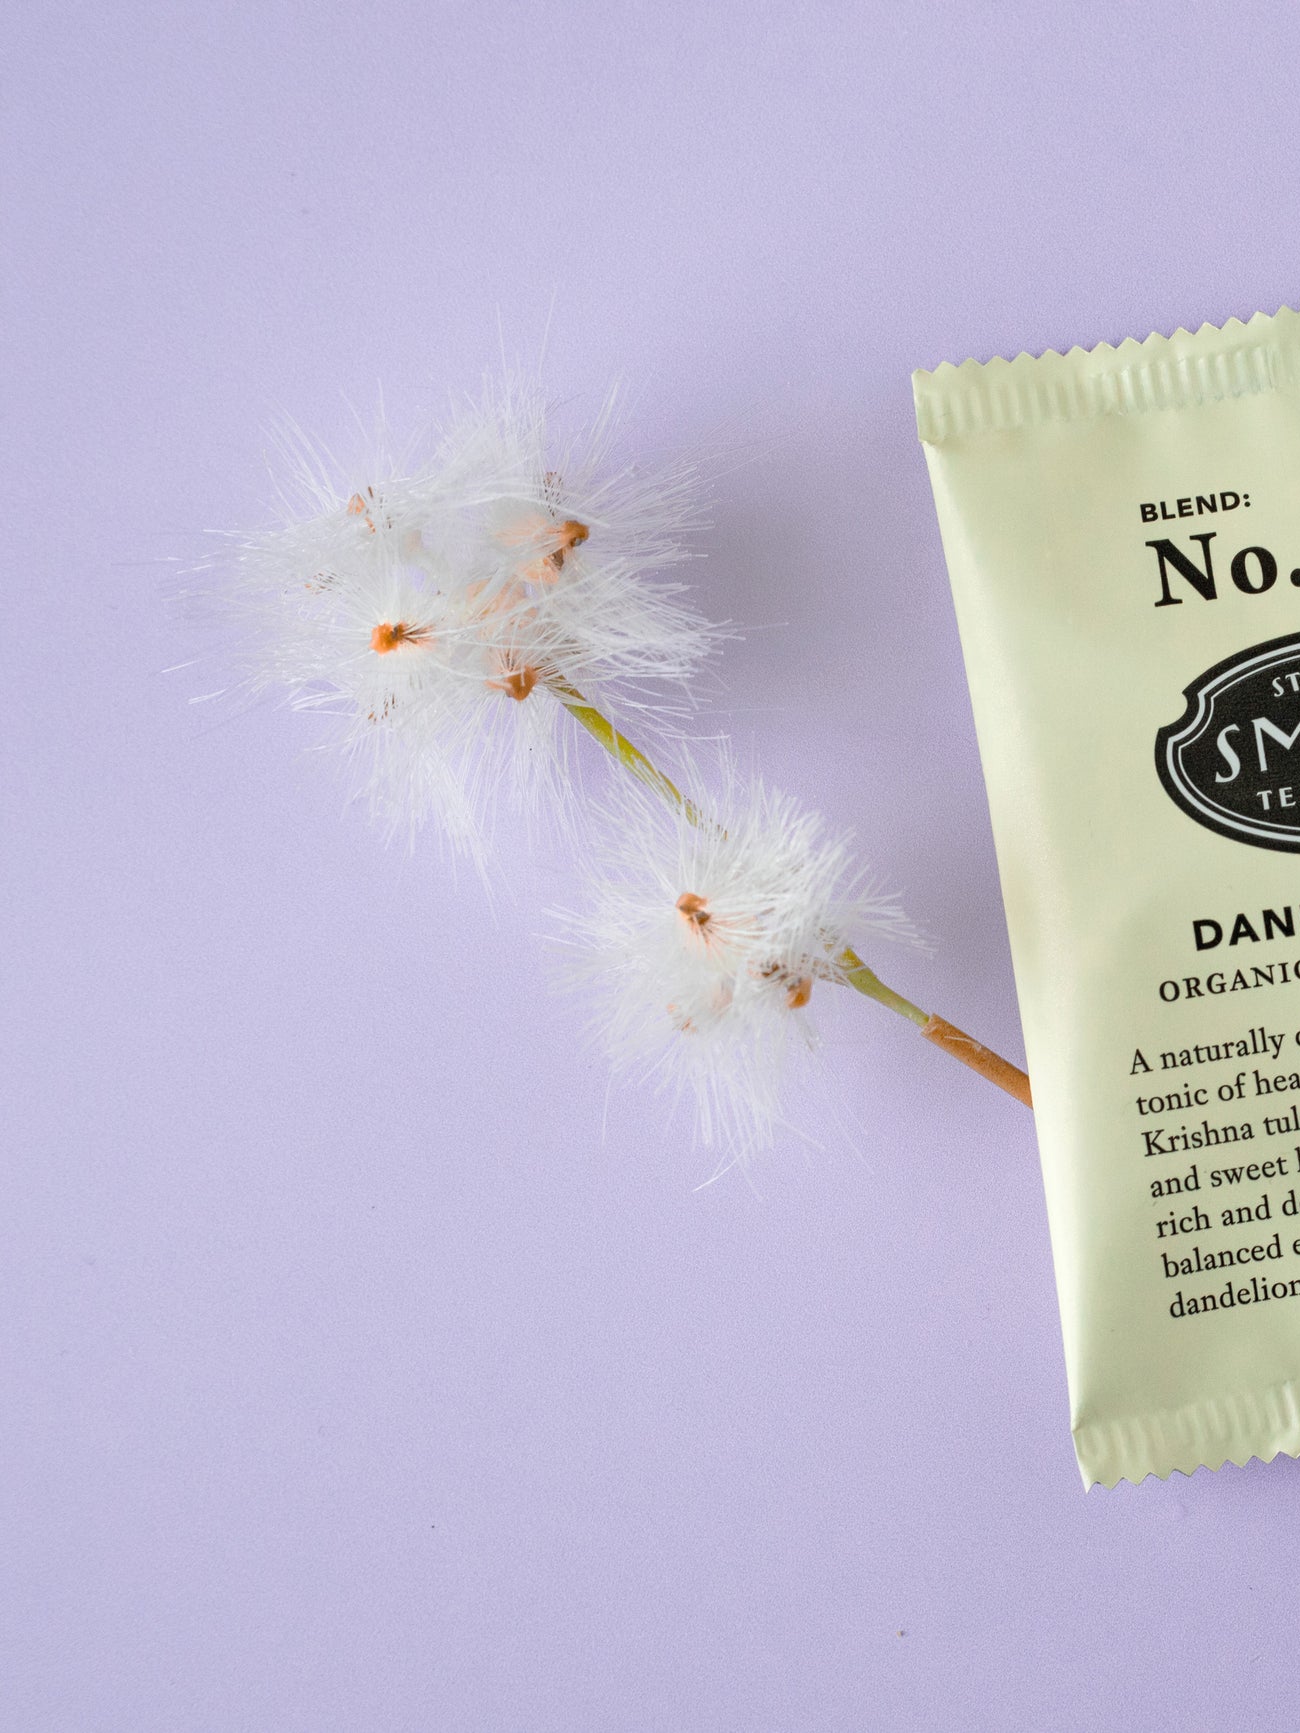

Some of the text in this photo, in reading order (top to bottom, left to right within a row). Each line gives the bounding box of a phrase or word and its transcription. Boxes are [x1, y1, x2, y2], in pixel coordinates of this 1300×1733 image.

[1139, 491, 1251, 524] BLEND:
[1129, 1048, 1154, 1076] A
[1159, 1026, 1286, 1071] naturally
[1135, 1082, 1209, 1116] tonic
[1217, 1071, 1247, 1102] of
[1140, 1119, 1256, 1158] Krishna
[1149, 1164, 1202, 1199] and
[1209, 1156, 1289, 1188] sweet
[1155, 1205, 1213, 1239] rich
[1220, 1193, 1273, 1227] and
[1160, 1232, 1284, 1279] balanced
